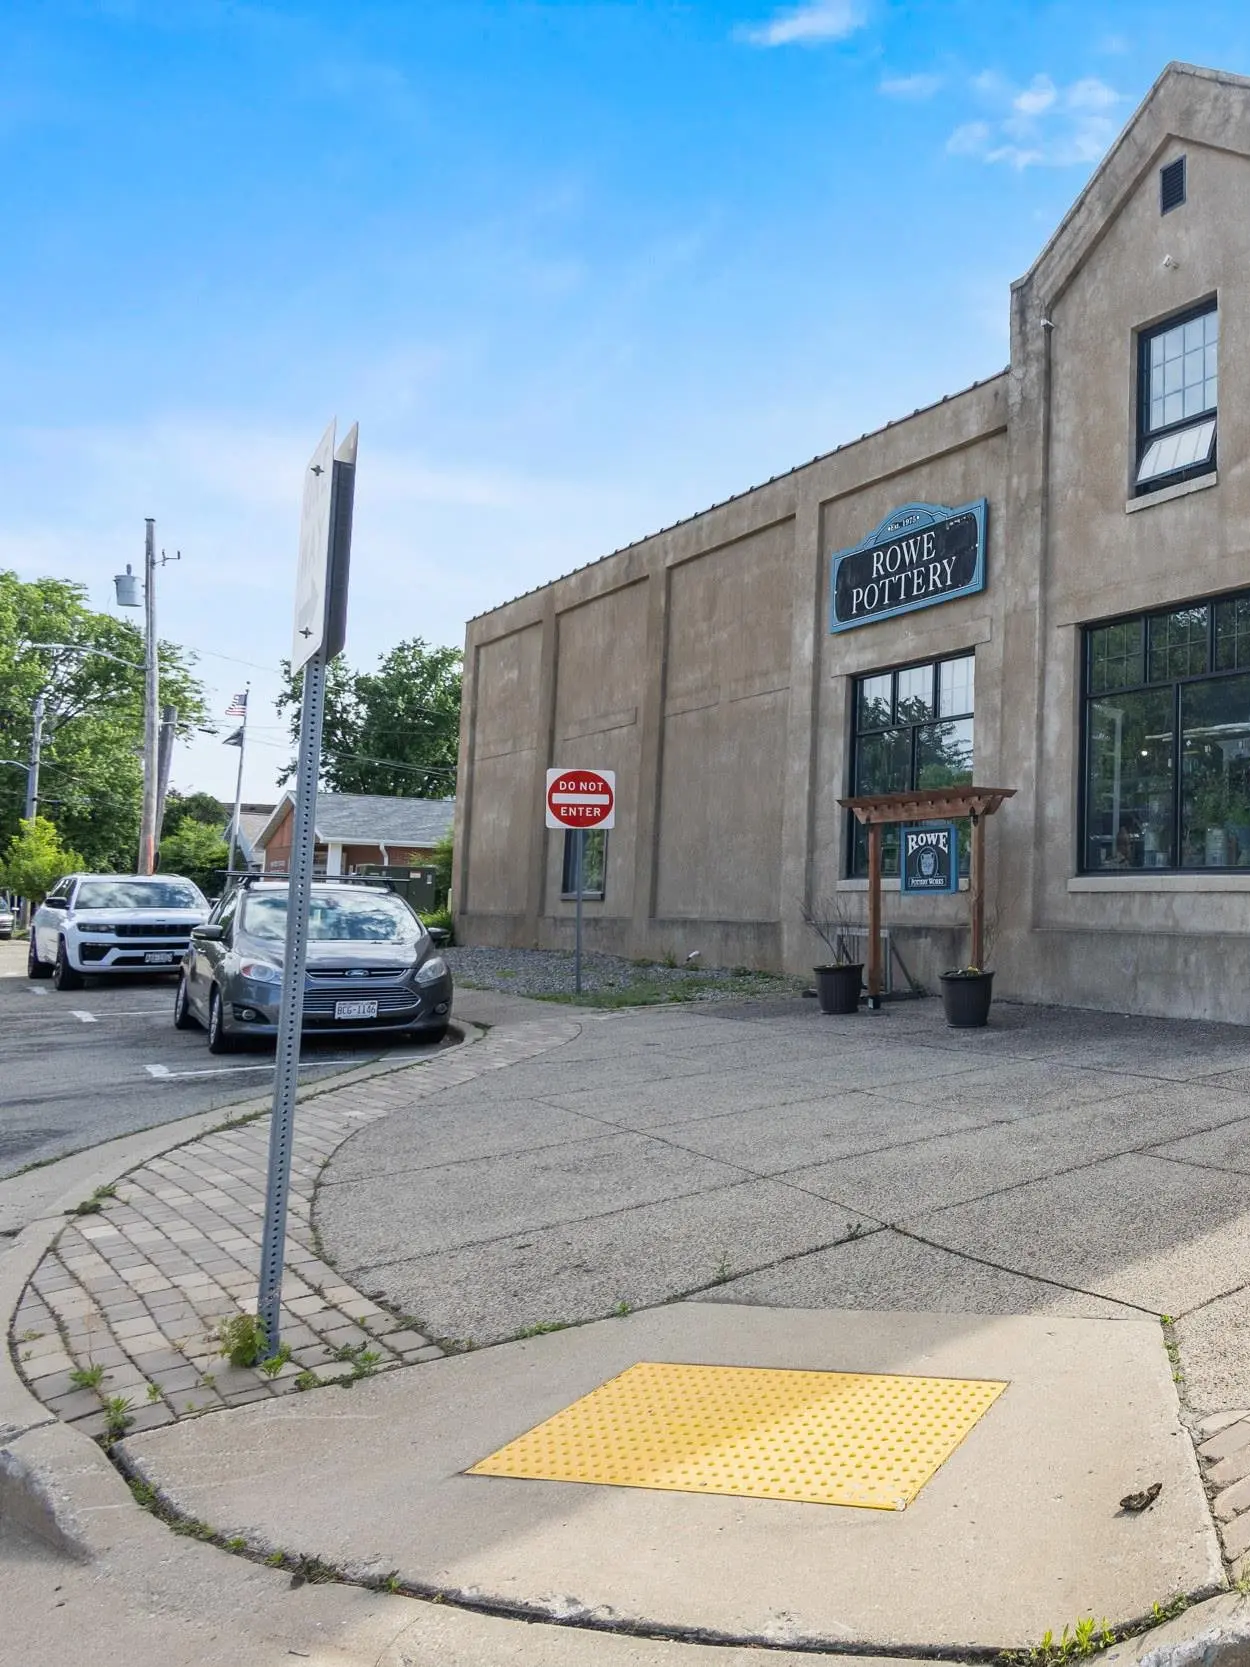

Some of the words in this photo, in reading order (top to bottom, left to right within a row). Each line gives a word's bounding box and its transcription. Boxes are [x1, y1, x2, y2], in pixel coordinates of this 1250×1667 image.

[871, 531, 936, 579] ROWE
[851, 556, 957, 615] POTTERY
[559, 781, 576, 791] DO
[580, 782, 603, 792] NOT
[560, 806, 601, 817] ENTER
[907, 831, 948, 857] ROWE
